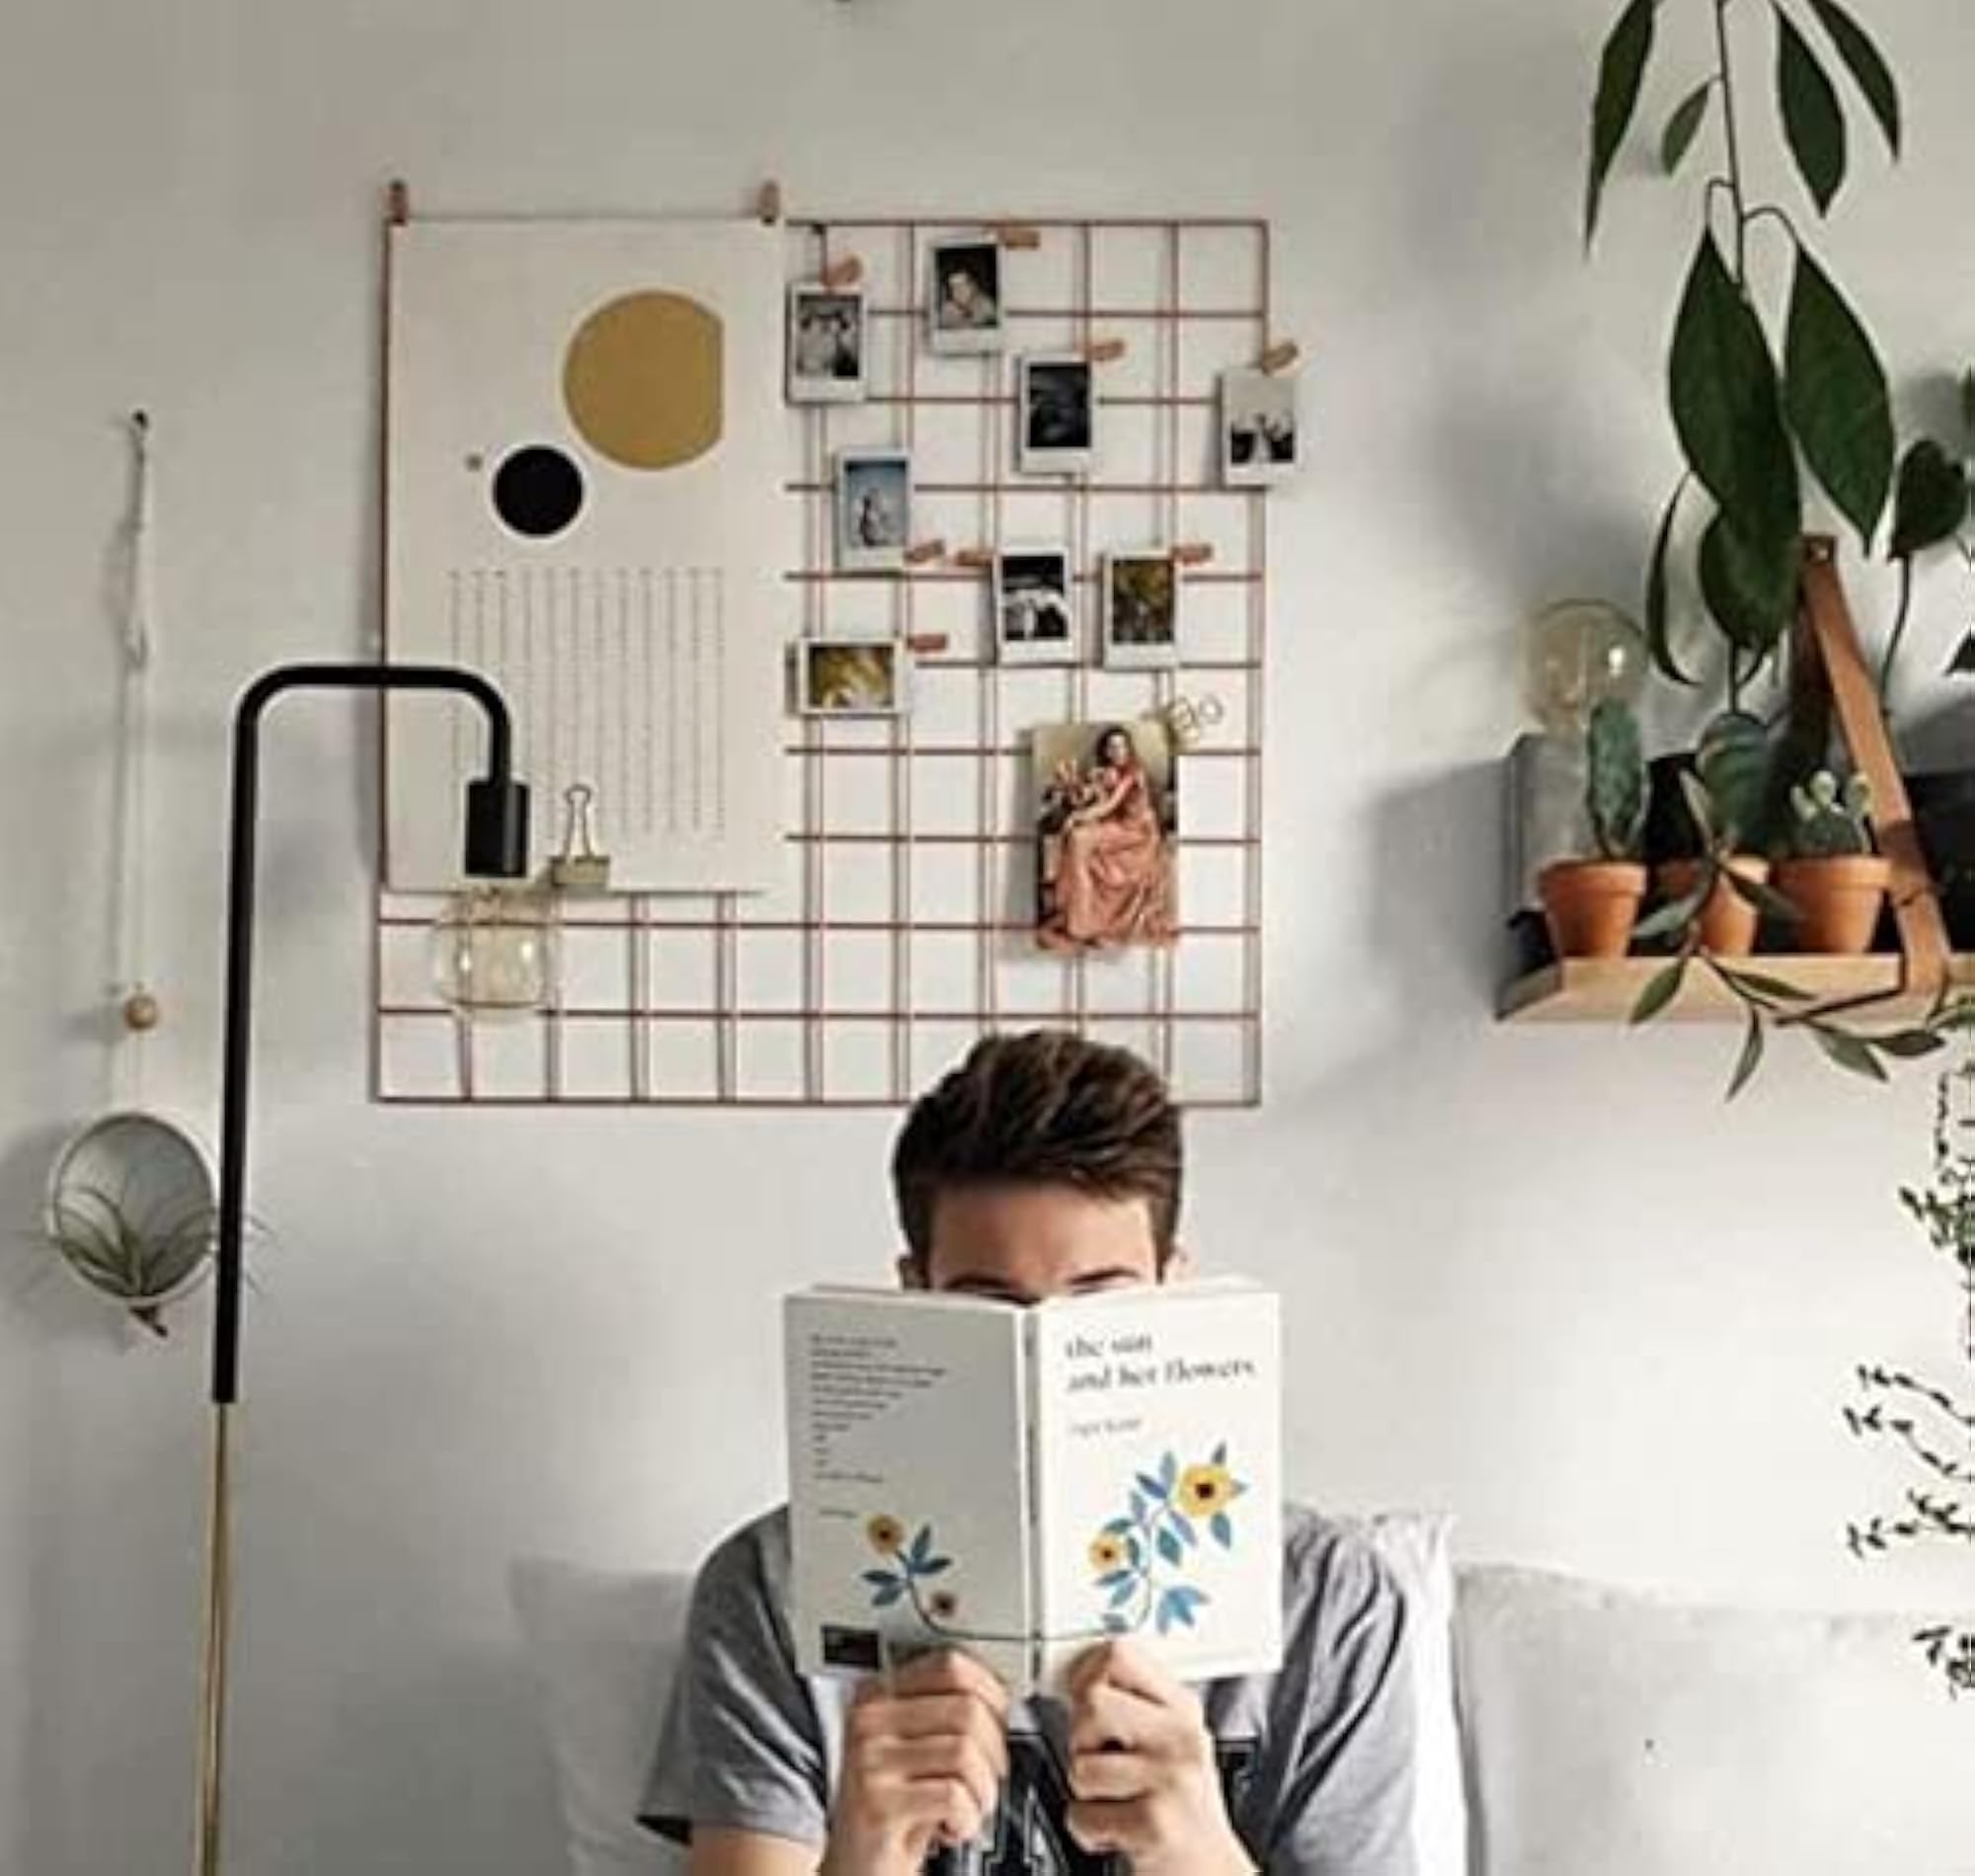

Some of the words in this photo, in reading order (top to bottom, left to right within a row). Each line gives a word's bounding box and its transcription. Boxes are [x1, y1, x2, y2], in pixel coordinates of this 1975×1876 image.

[1066, 1334, 1102, 1359] the
[1067, 1364, 1112, 1390] and
[1119, 1364, 1156, 1385] her
[1165, 1359, 1256, 1384] flowers
